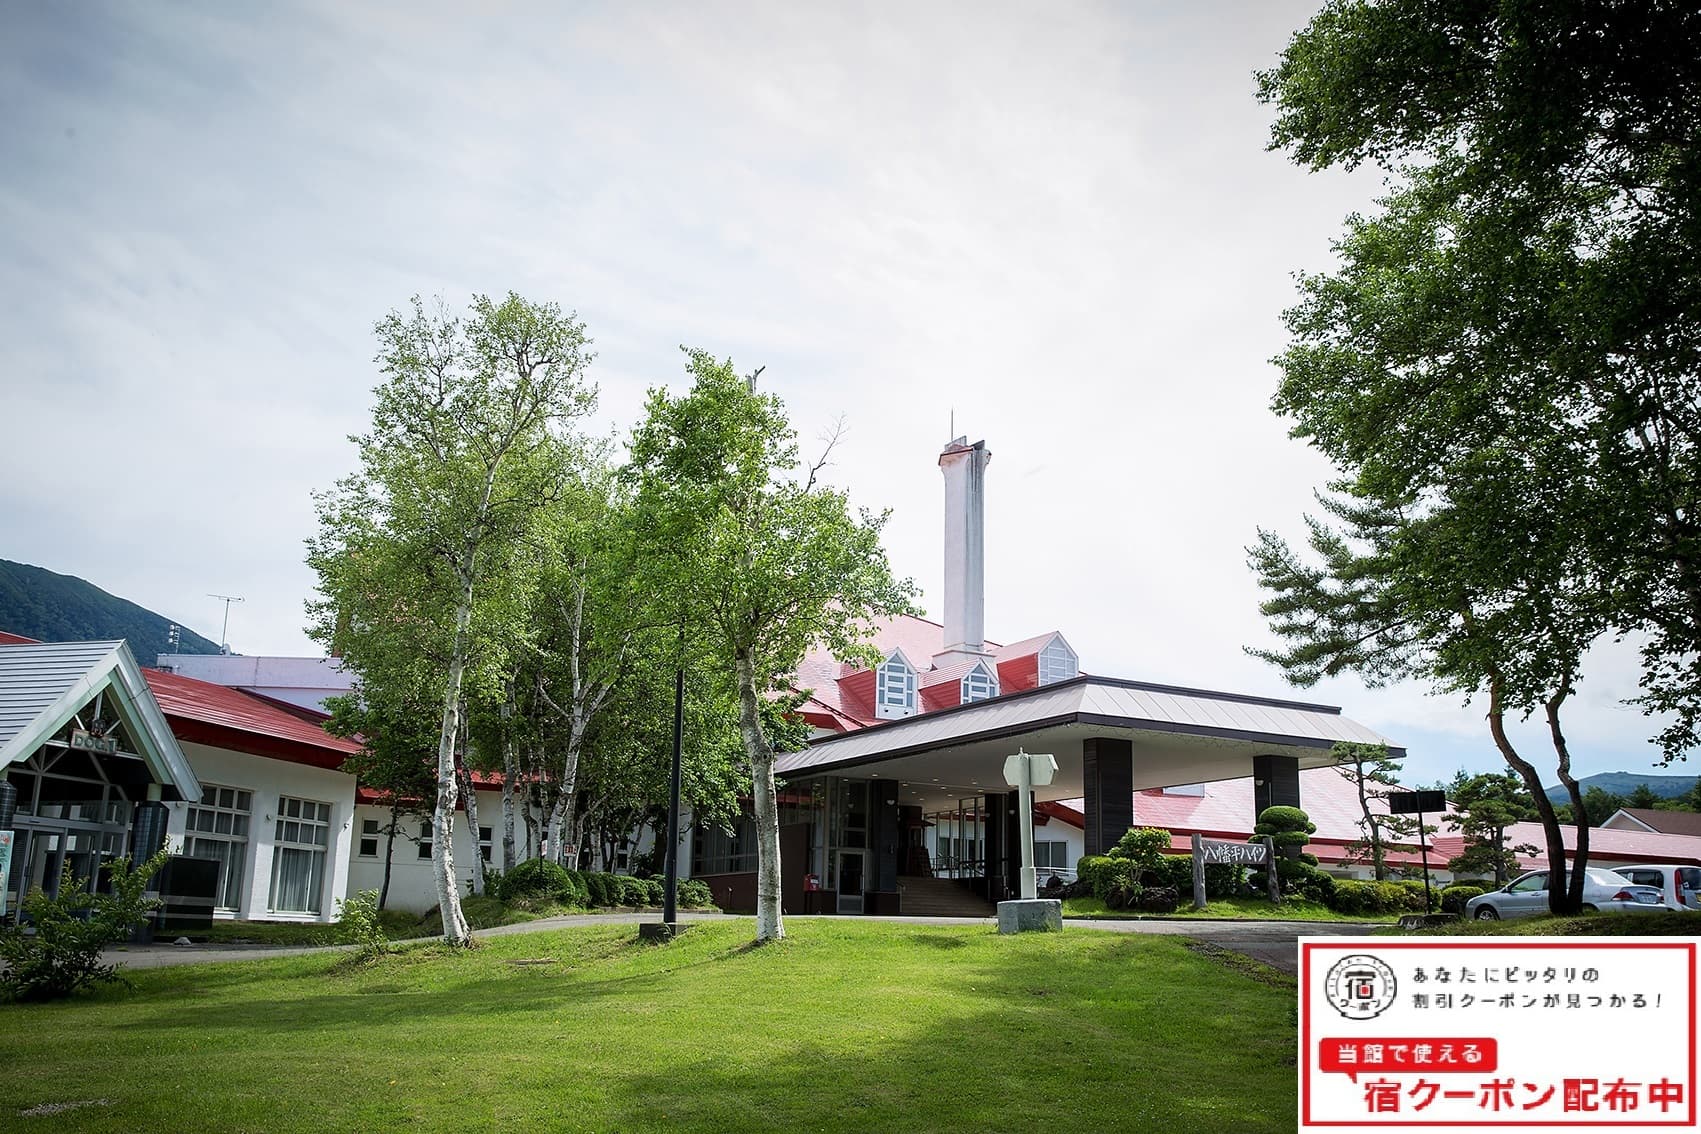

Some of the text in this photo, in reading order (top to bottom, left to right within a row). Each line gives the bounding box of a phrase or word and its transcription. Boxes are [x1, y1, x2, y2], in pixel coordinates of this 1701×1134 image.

[1204, 843, 1267, 864] 八幡平ハイツ
